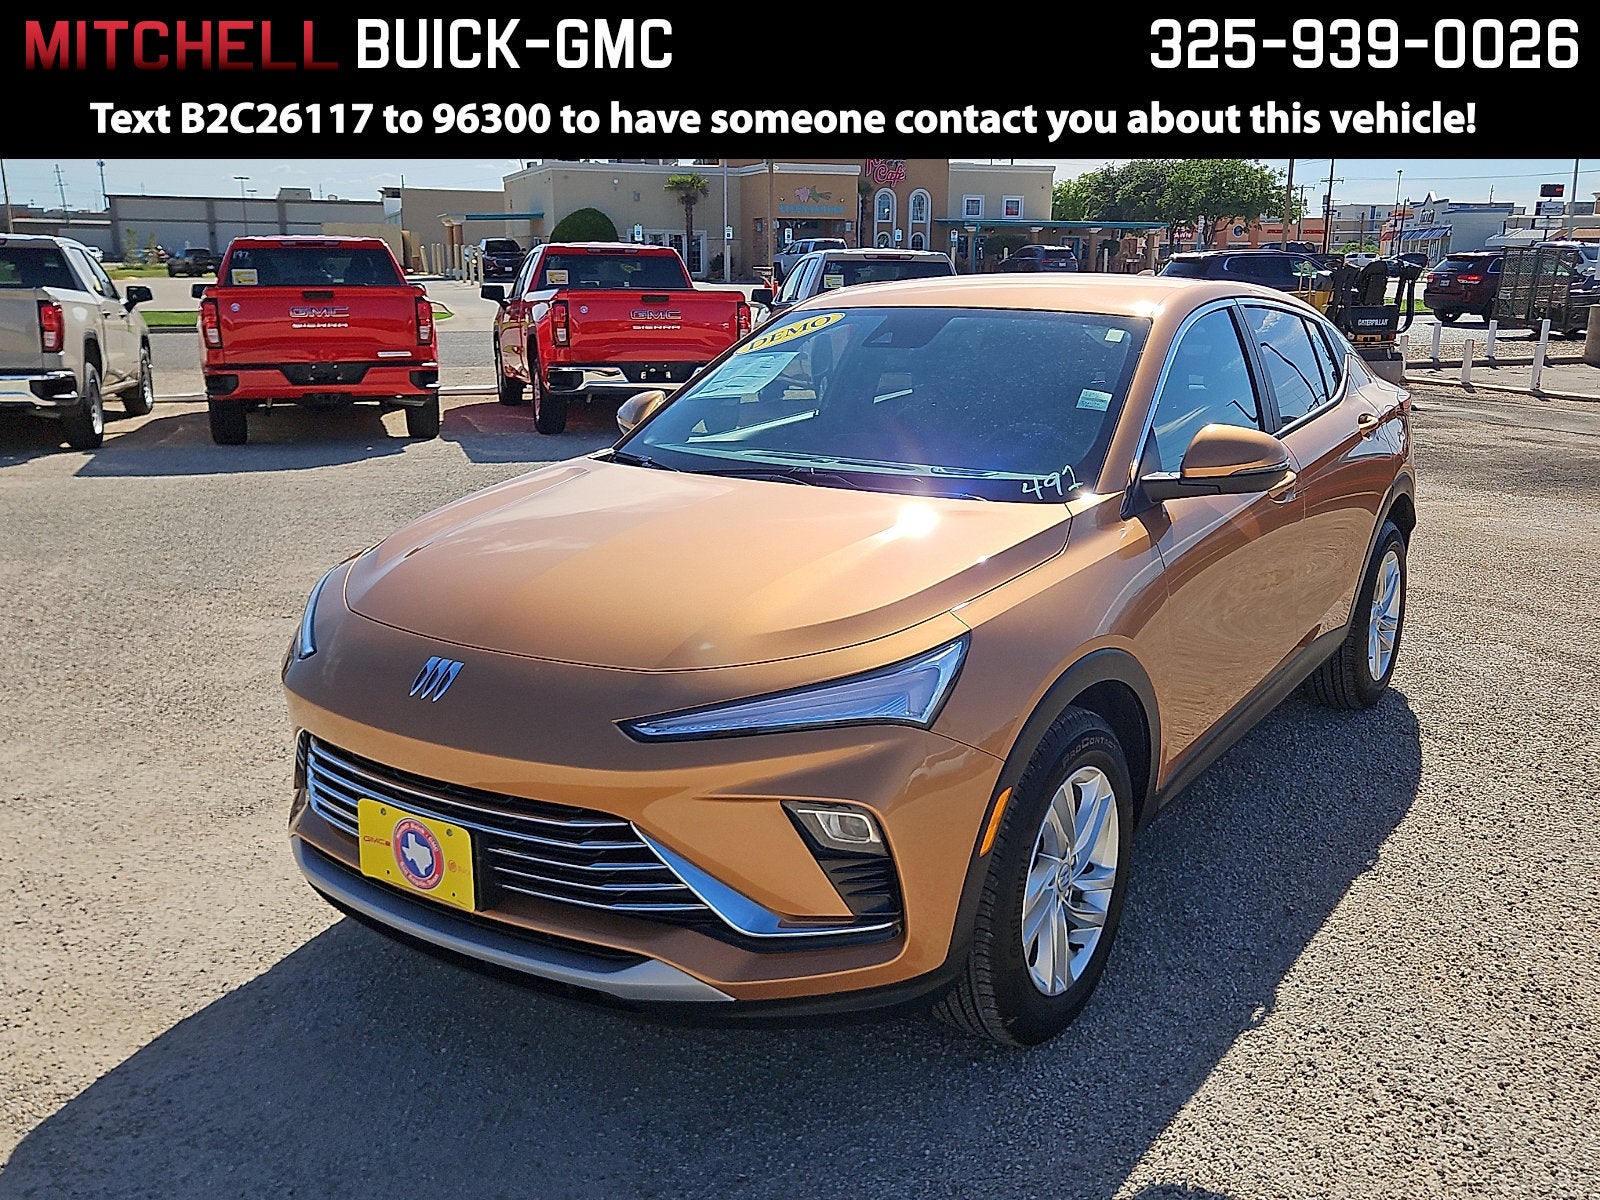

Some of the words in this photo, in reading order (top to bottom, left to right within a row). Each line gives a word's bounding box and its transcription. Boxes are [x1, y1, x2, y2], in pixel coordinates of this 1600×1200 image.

[289, 305, 350, 318] GMC
[630, 309, 682, 320] GMC
[1357, 318, 1389, 327] CATERPILLAR
[748, 313, 833, 352] DEMO
